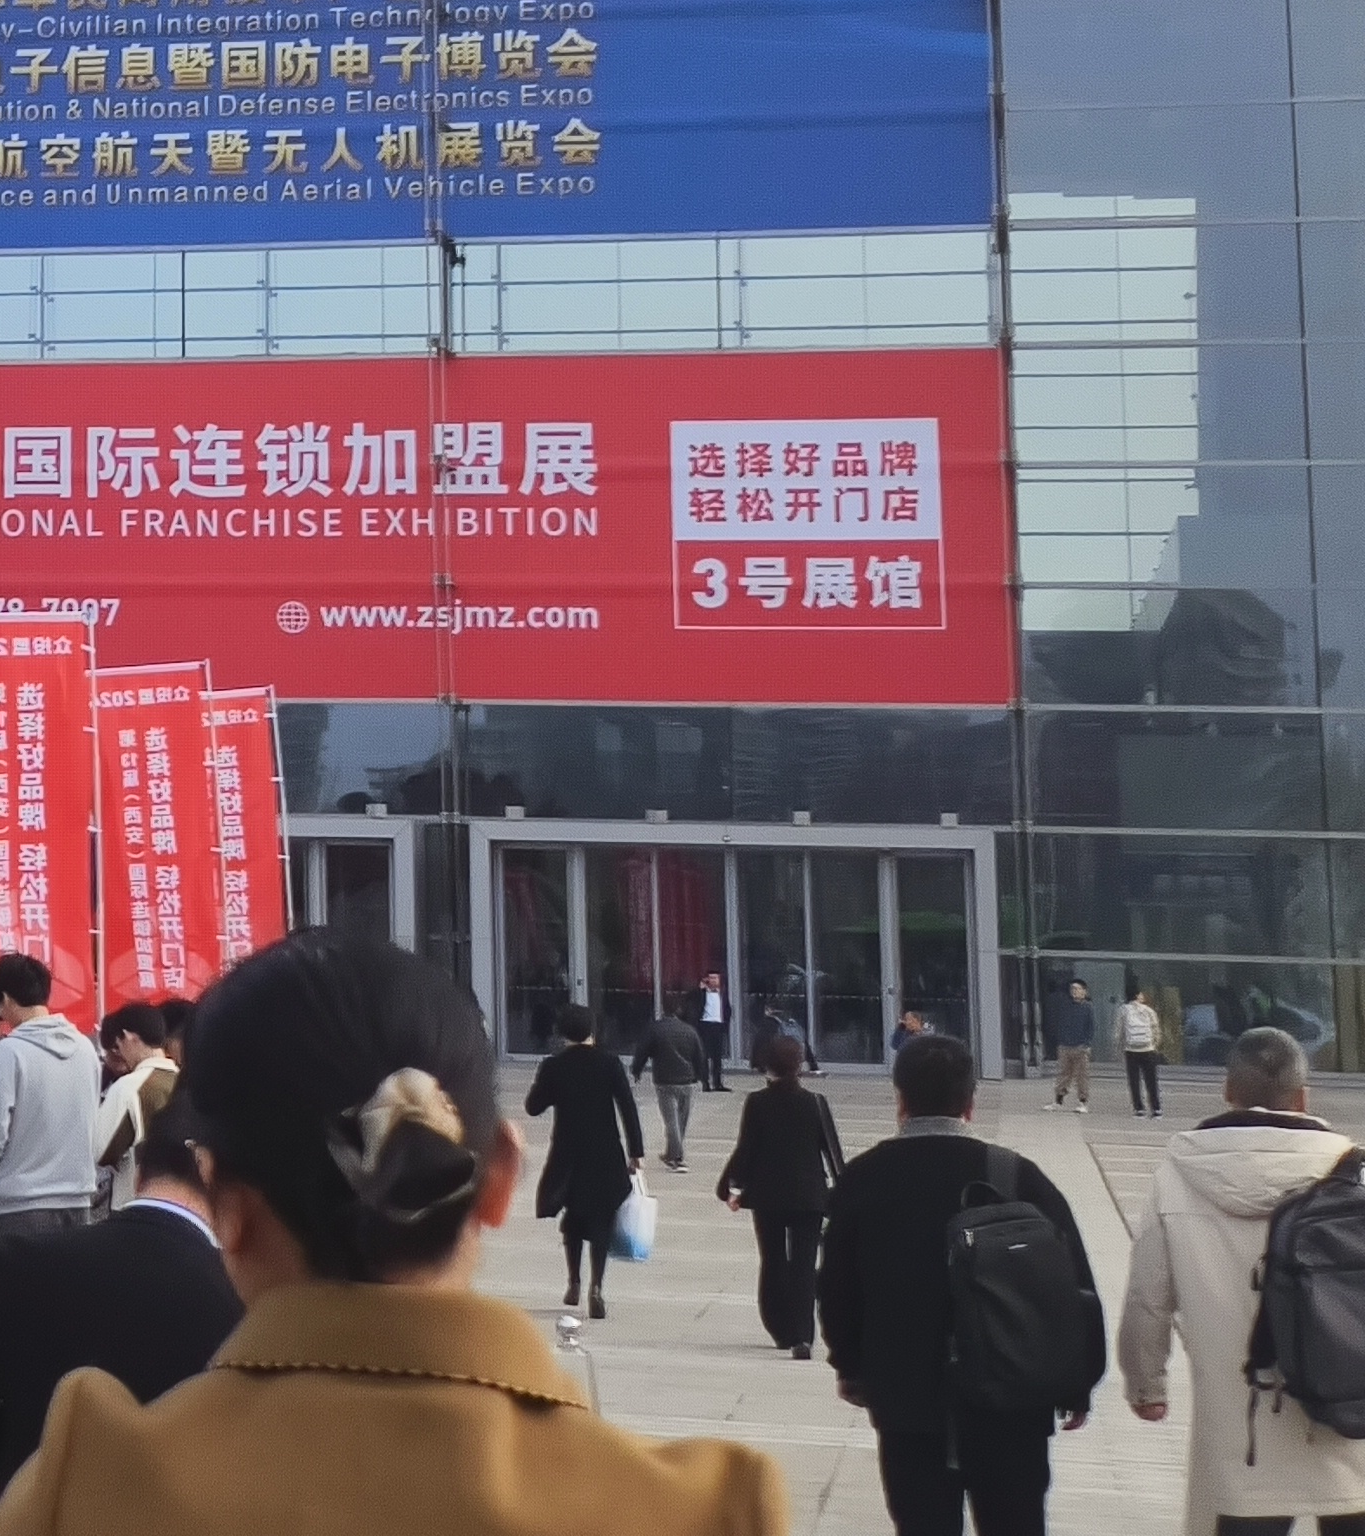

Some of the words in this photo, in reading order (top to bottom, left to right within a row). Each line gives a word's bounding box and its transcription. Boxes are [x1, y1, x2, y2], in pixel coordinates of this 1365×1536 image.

[156, 5, 320, 37] Integration
[519, 0, 595, 24] Expo
[65, 100, 82, 121] &
[92, 95, 210, 122] National
[218, 91, 336, 118] Defense
[345, 88, 510, 114] Electronics
[517, 85, 593, 110] Expo
[42, 184, 96, 205] and
[106, 175, 269, 205] Unmanned
[279, 175, 373, 202] Aerial
[384, 174, 506, 200] Vehicle
[516, 172, 595, 197] Expo
[687, 440, 918, 478] 选择好品牌
[120, 507, 344, 537] FRANCHISE
[359, 506, 599, 537] EXHIBITION
[688, 486, 919, 523] 轻松开门店
[691, 555, 923, 609] 3号展馆
[319, 597, 600, 636] www.zsjmz.com
